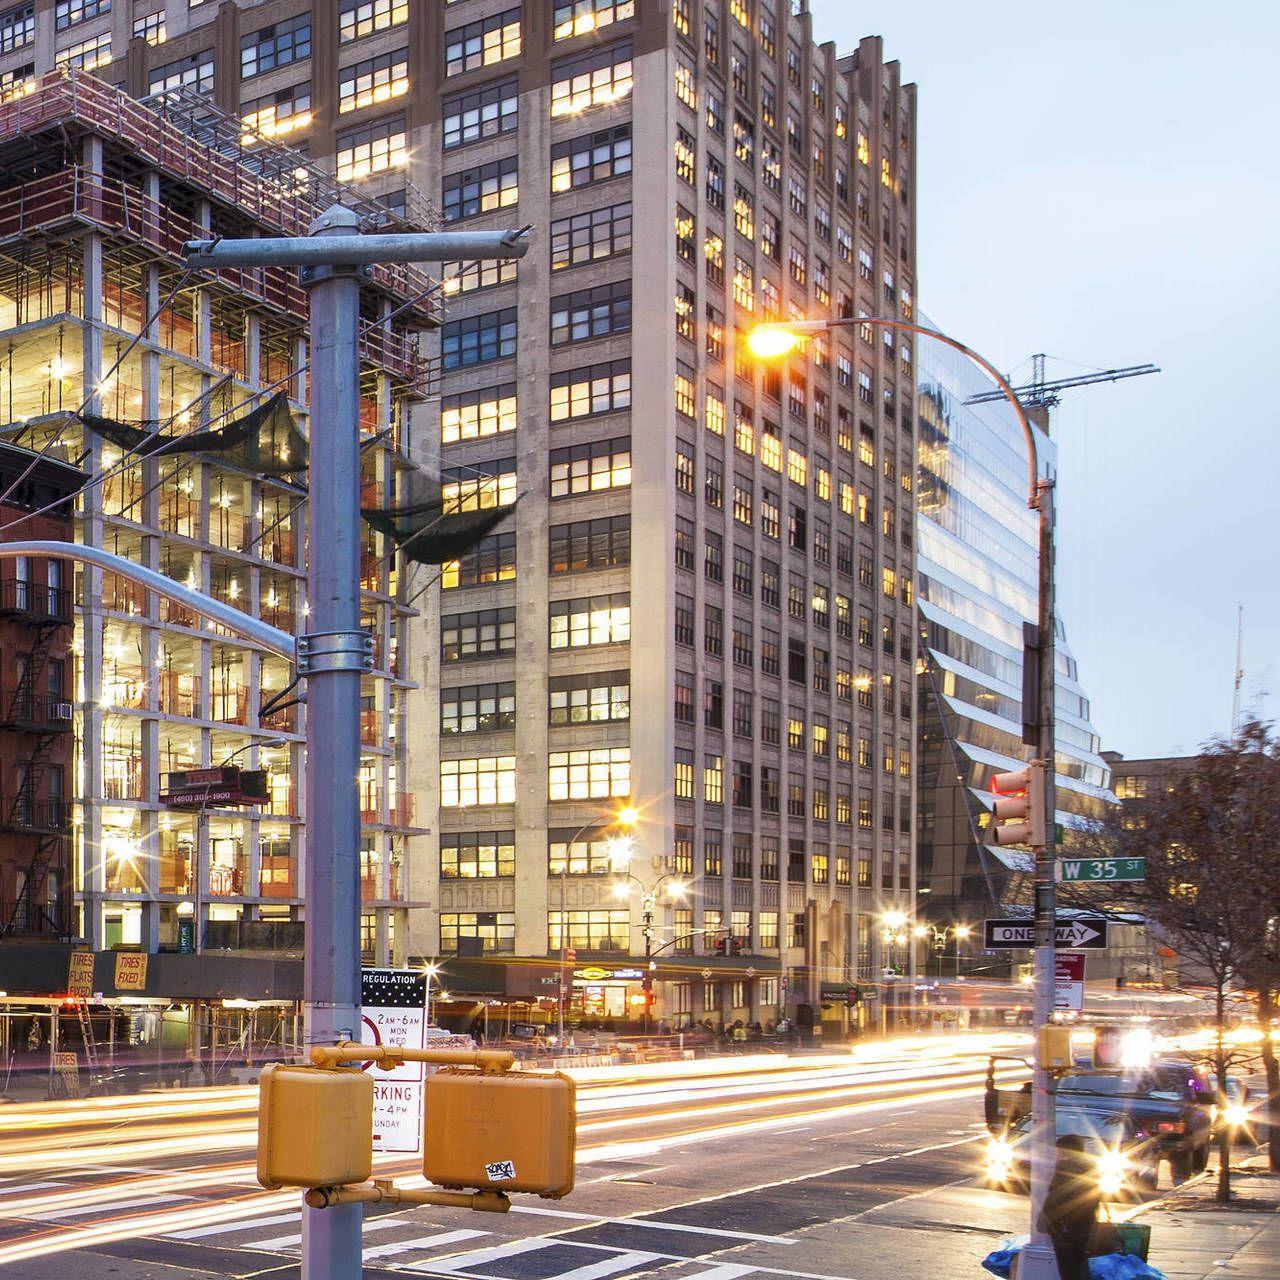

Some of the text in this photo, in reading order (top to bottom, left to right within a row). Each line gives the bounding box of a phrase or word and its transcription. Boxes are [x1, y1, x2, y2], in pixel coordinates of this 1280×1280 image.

[1065, 861, 1139, 879] W 35 ST
[1002, 928, 1036, 941] ONE
[72, 954, 94, 966] TIRES
[121, 956, 141, 968] TIRES
[119, 972, 139, 984] FIXED
[362, 974, 416, 984] REGULATION
[390, 1026, 408, 1035] MON
[388, 1037, 407, 1045] WED
[374, 1086, 412, 1101] RKING
[374, 1120, 400, 1128] UNDAY
